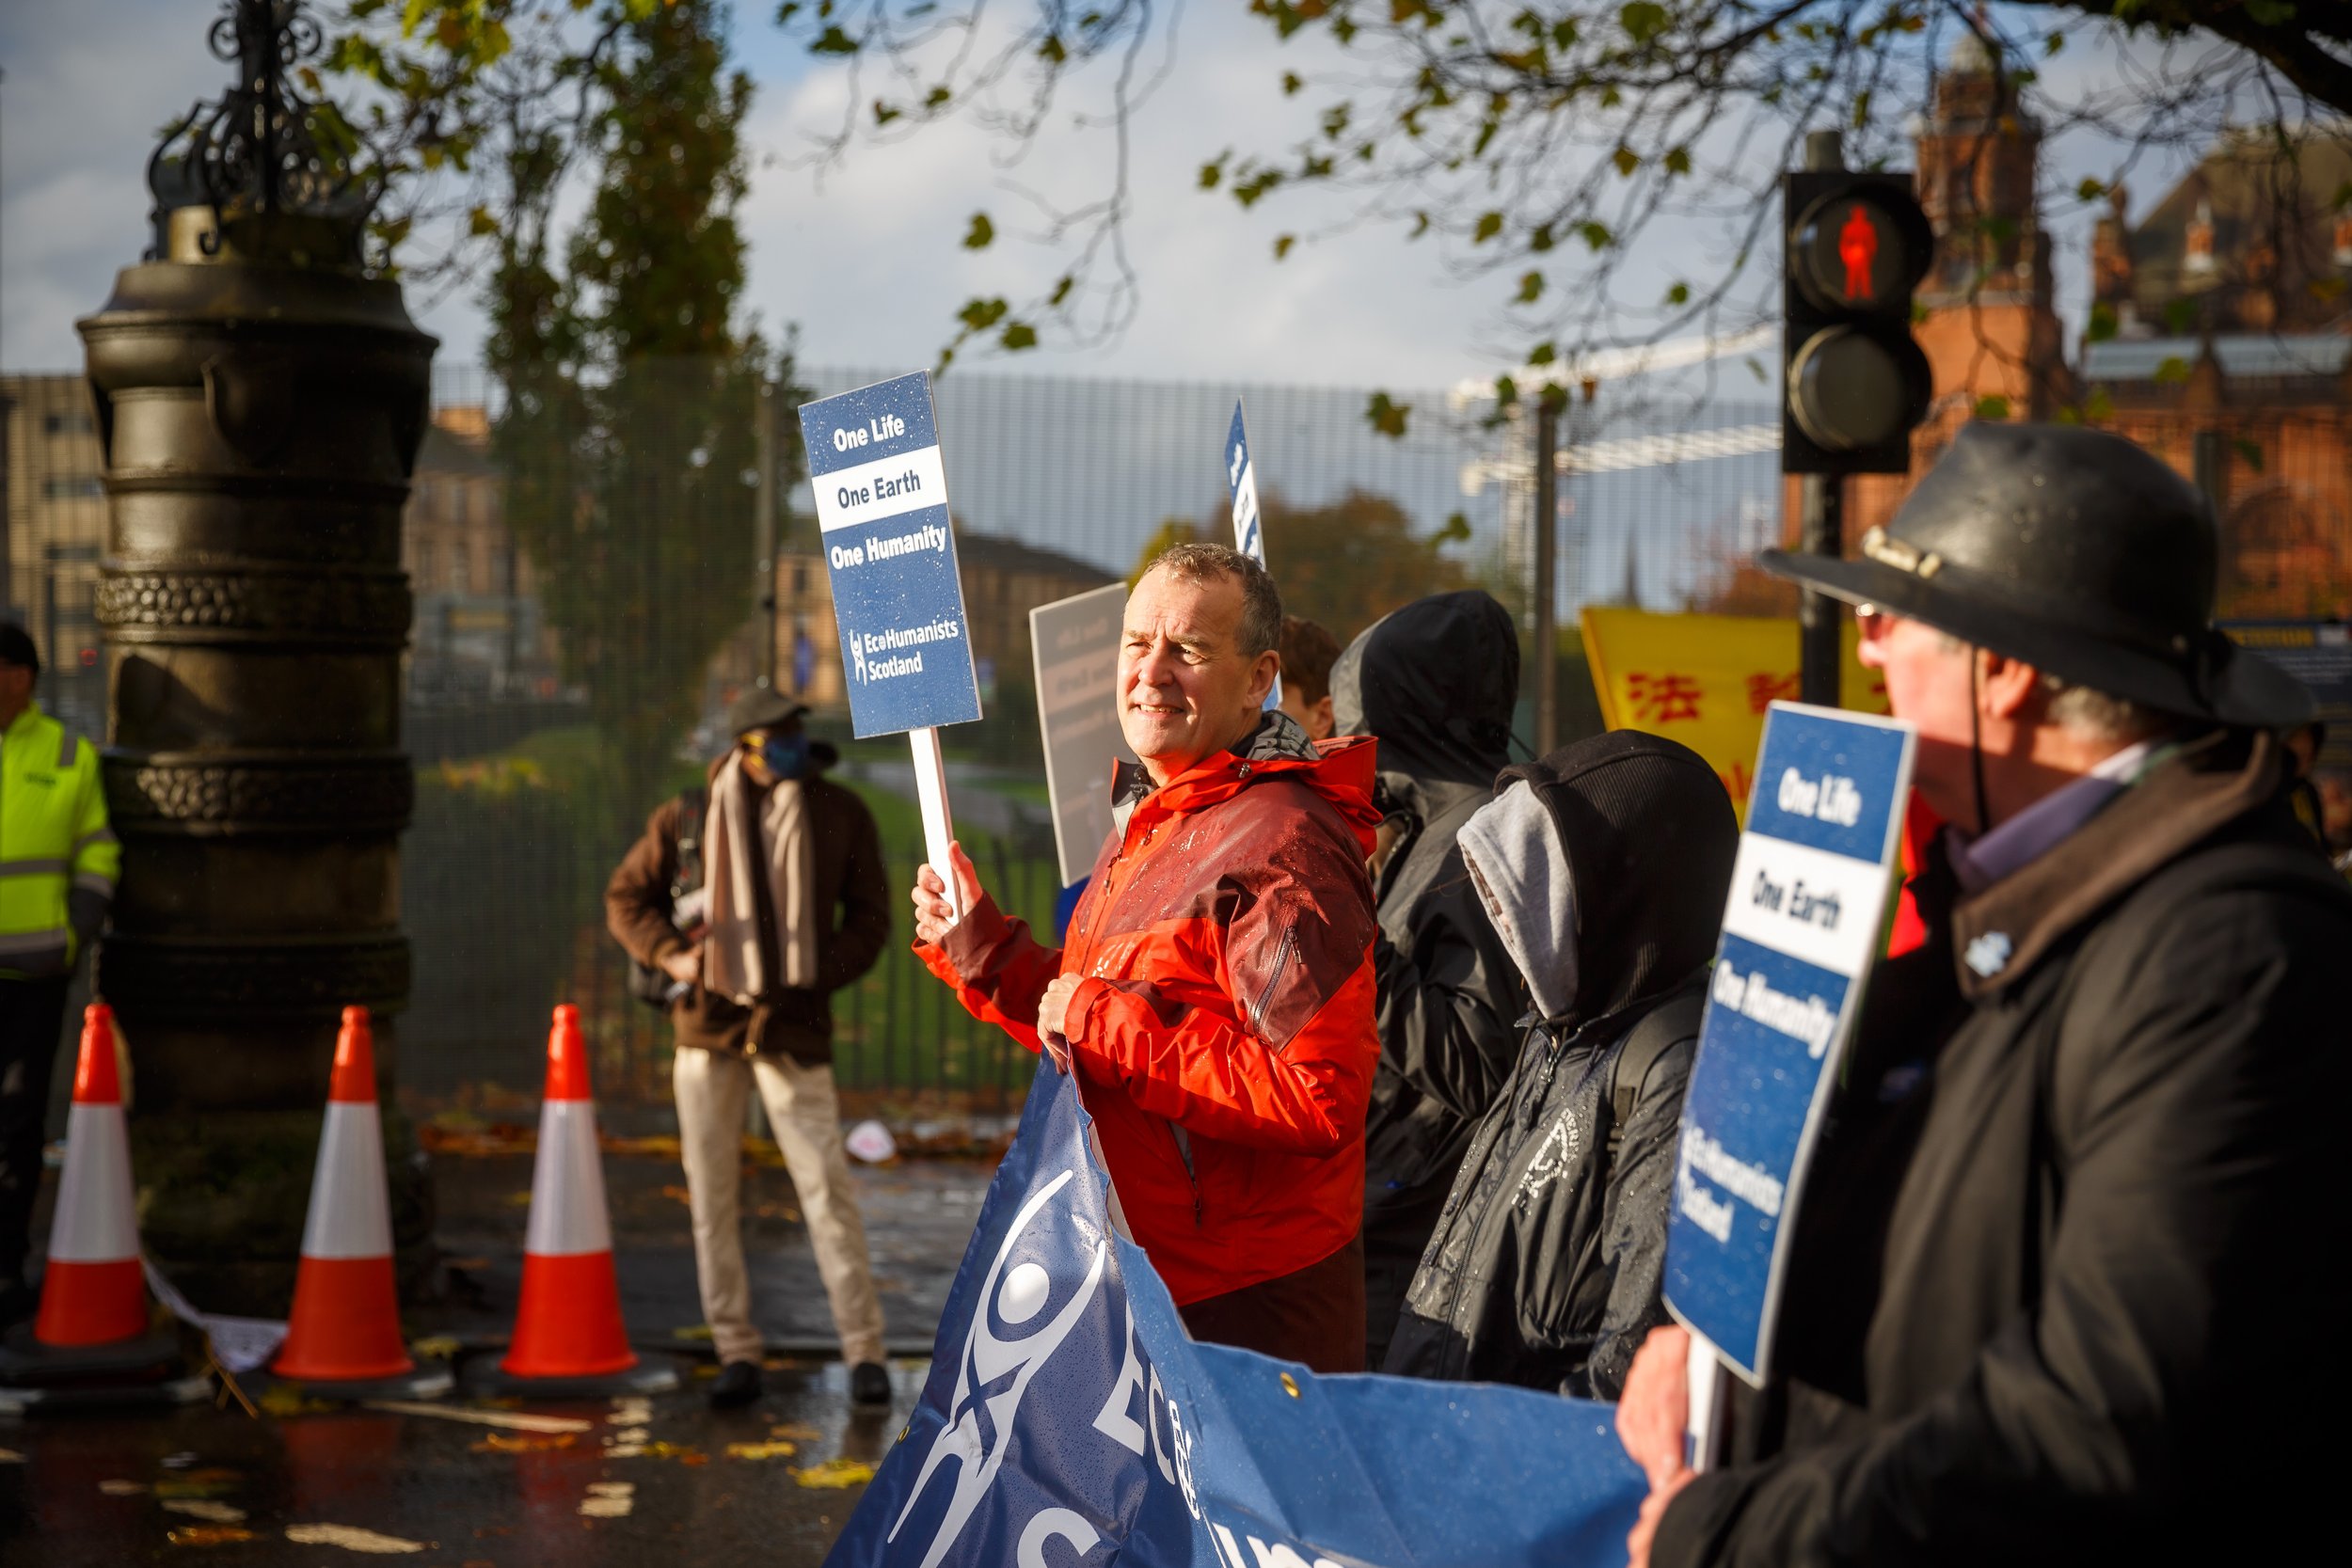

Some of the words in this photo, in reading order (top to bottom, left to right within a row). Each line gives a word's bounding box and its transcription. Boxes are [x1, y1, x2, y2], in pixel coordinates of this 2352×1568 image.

[834, 428, 868, 452] One
[870, 413, 904, 442] Life
[837, 486, 869, 509] One
[873, 469, 921, 499] Earth
[831, 546, 865, 570] One
[866, 524, 946, 562] Humanity
[864, 619, 959, 654] EcoHumanists
[868, 651, 924, 681] Scotland
[1777, 767, 1819, 817] One
[1816, 774, 1863, 828] Life
[1751, 870, 1785, 911] One
[1788, 879, 1841, 929] Earth
[1713, 958, 1746, 1012] One
